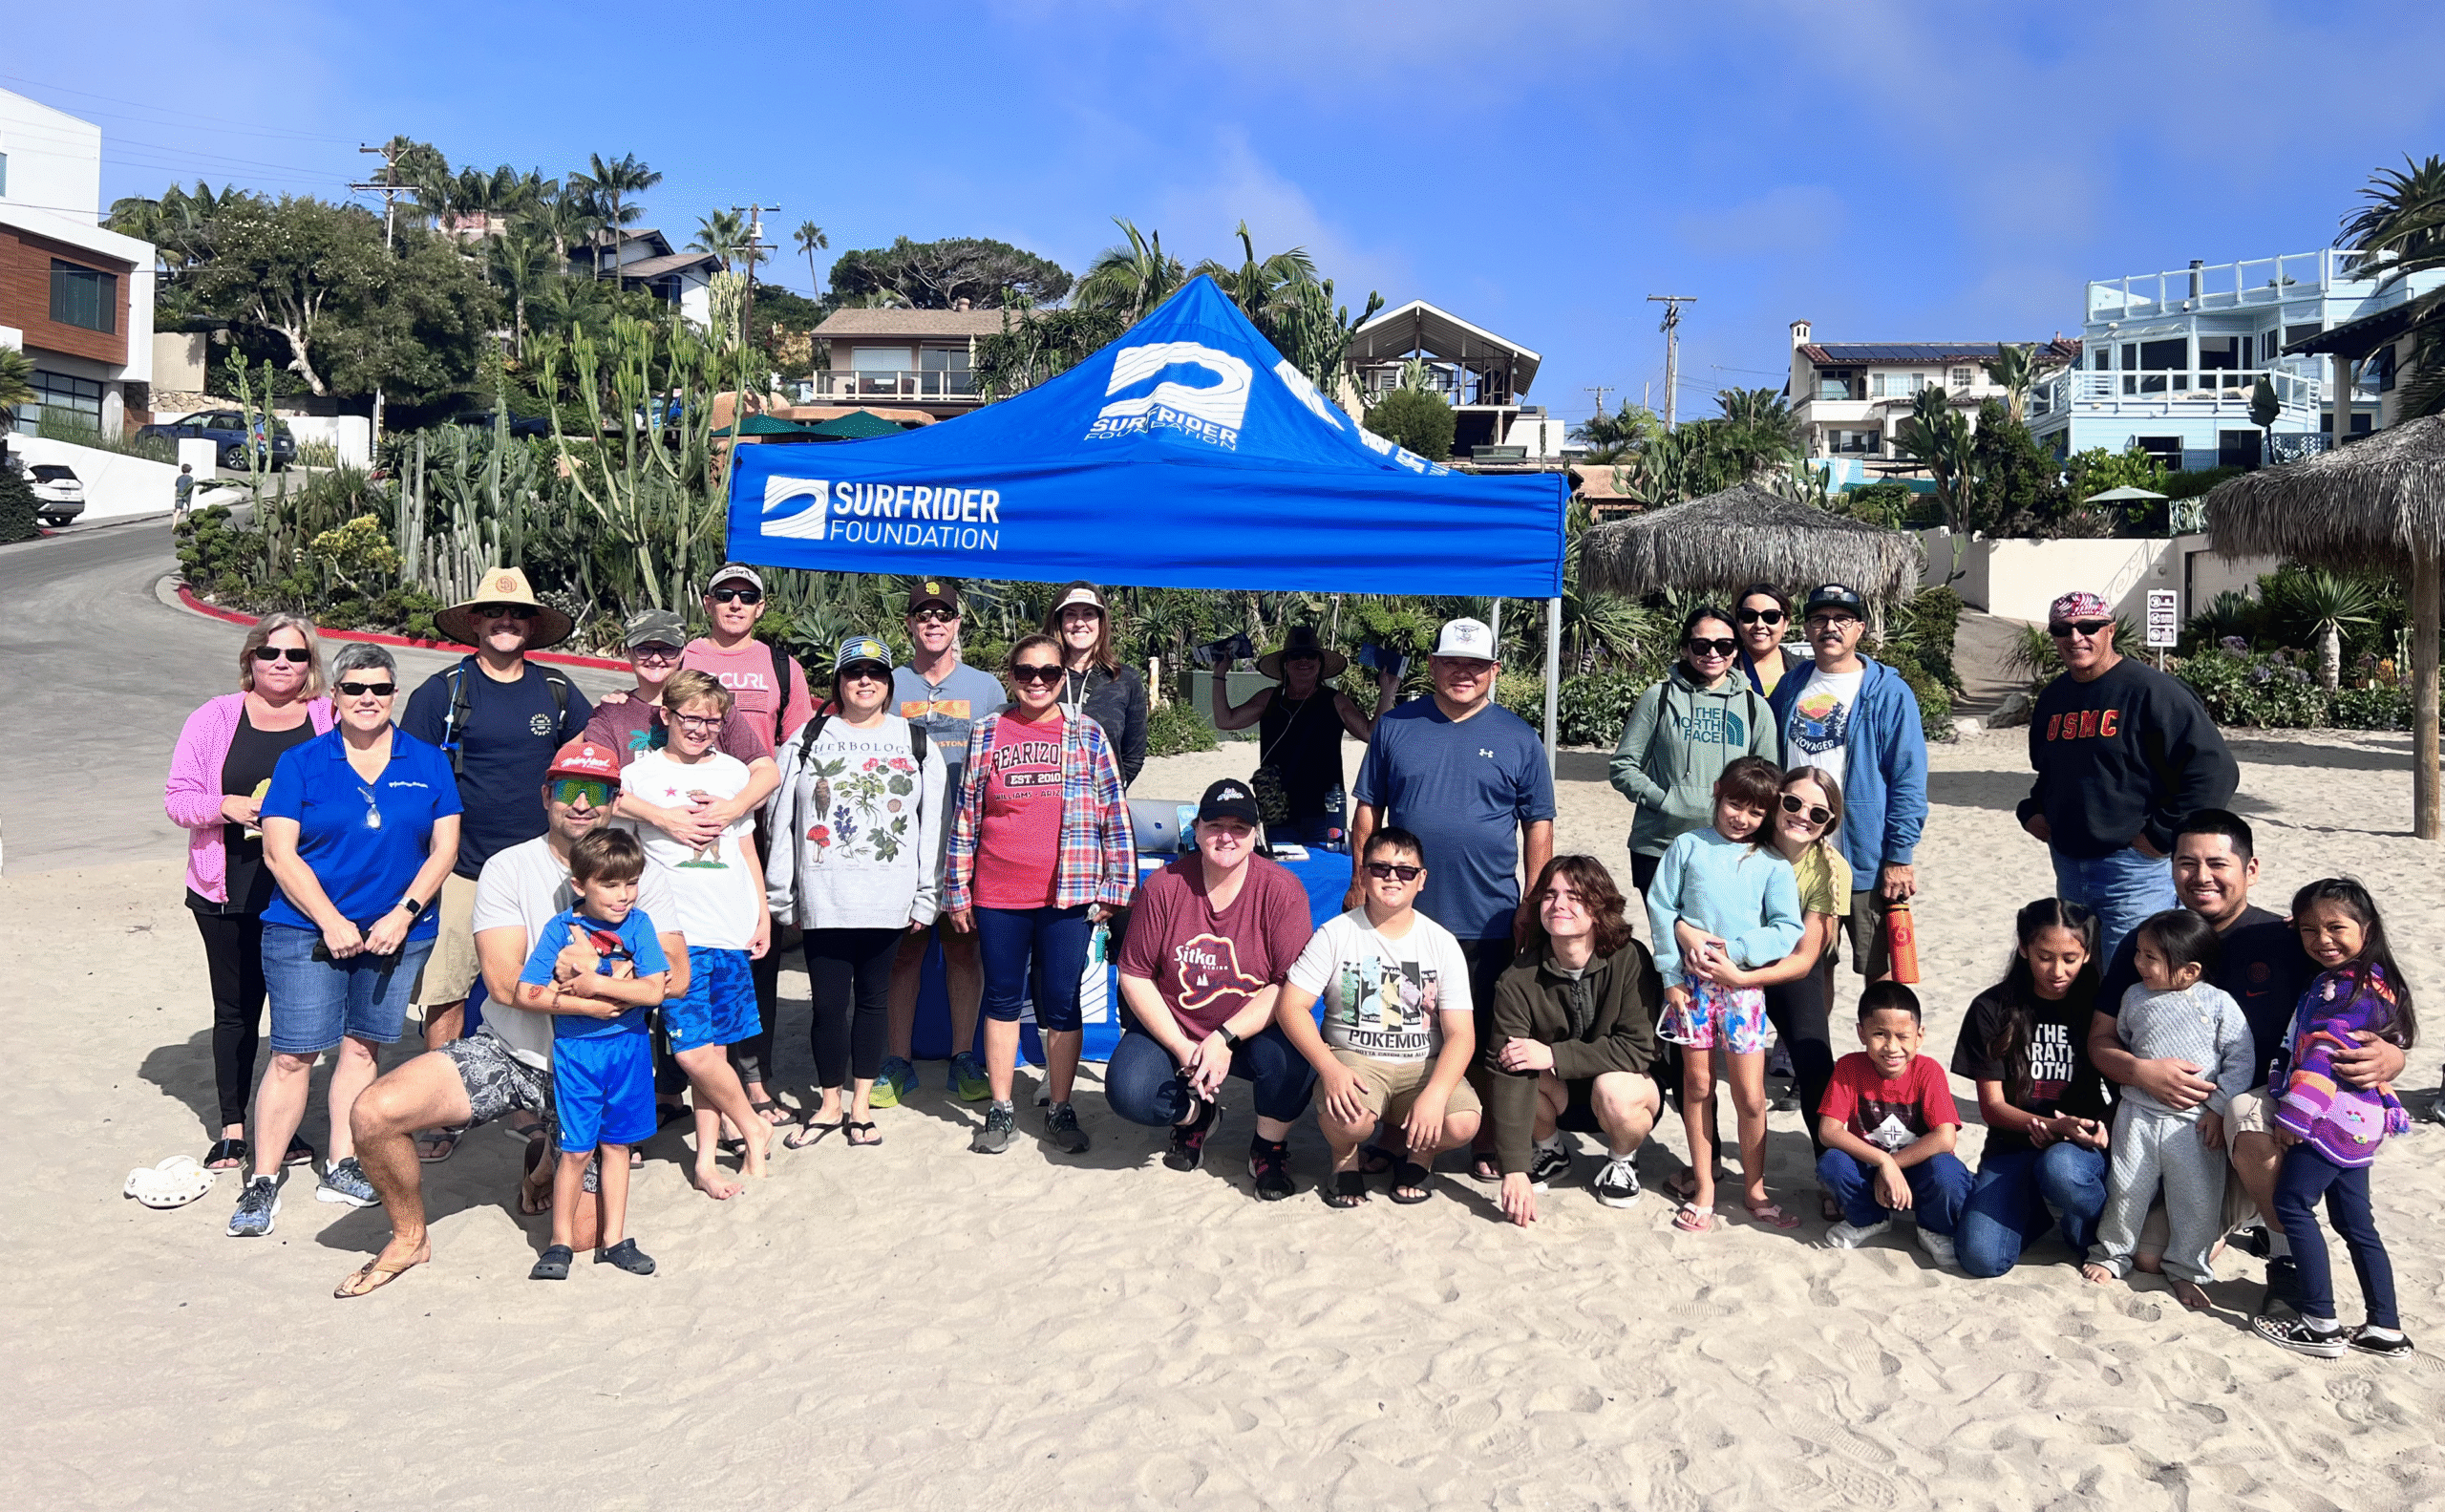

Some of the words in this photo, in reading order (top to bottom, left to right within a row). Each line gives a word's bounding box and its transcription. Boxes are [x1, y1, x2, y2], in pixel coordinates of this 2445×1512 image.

[1089, 405, 1238, 445] SURFRIDER
[1083, 420, 1237, 452] FOUNDATION
[833, 481, 1000, 524] SURFRIDER
[830, 520, 999, 551] FOUNDATION
[718, 672, 769, 689] CURL
[1695, 707, 1721, 719] THE
[1672, 716, 1721, 732] ORTH
[2047, 709, 2119, 741] USMC
[1684, 729, 1721, 743] FACE
[1796, 735, 1835, 752] VOYAGER
[989, 740, 1062, 772] BEARIZO
[1010, 775, 1035, 785] EST.
[1037, 773, 1062, 783] 2010
[1174, 945, 1217, 966] Sitka
[1348, 1029, 1431, 1049] POKEMON
[2035, 1023, 2069, 1044] THE
